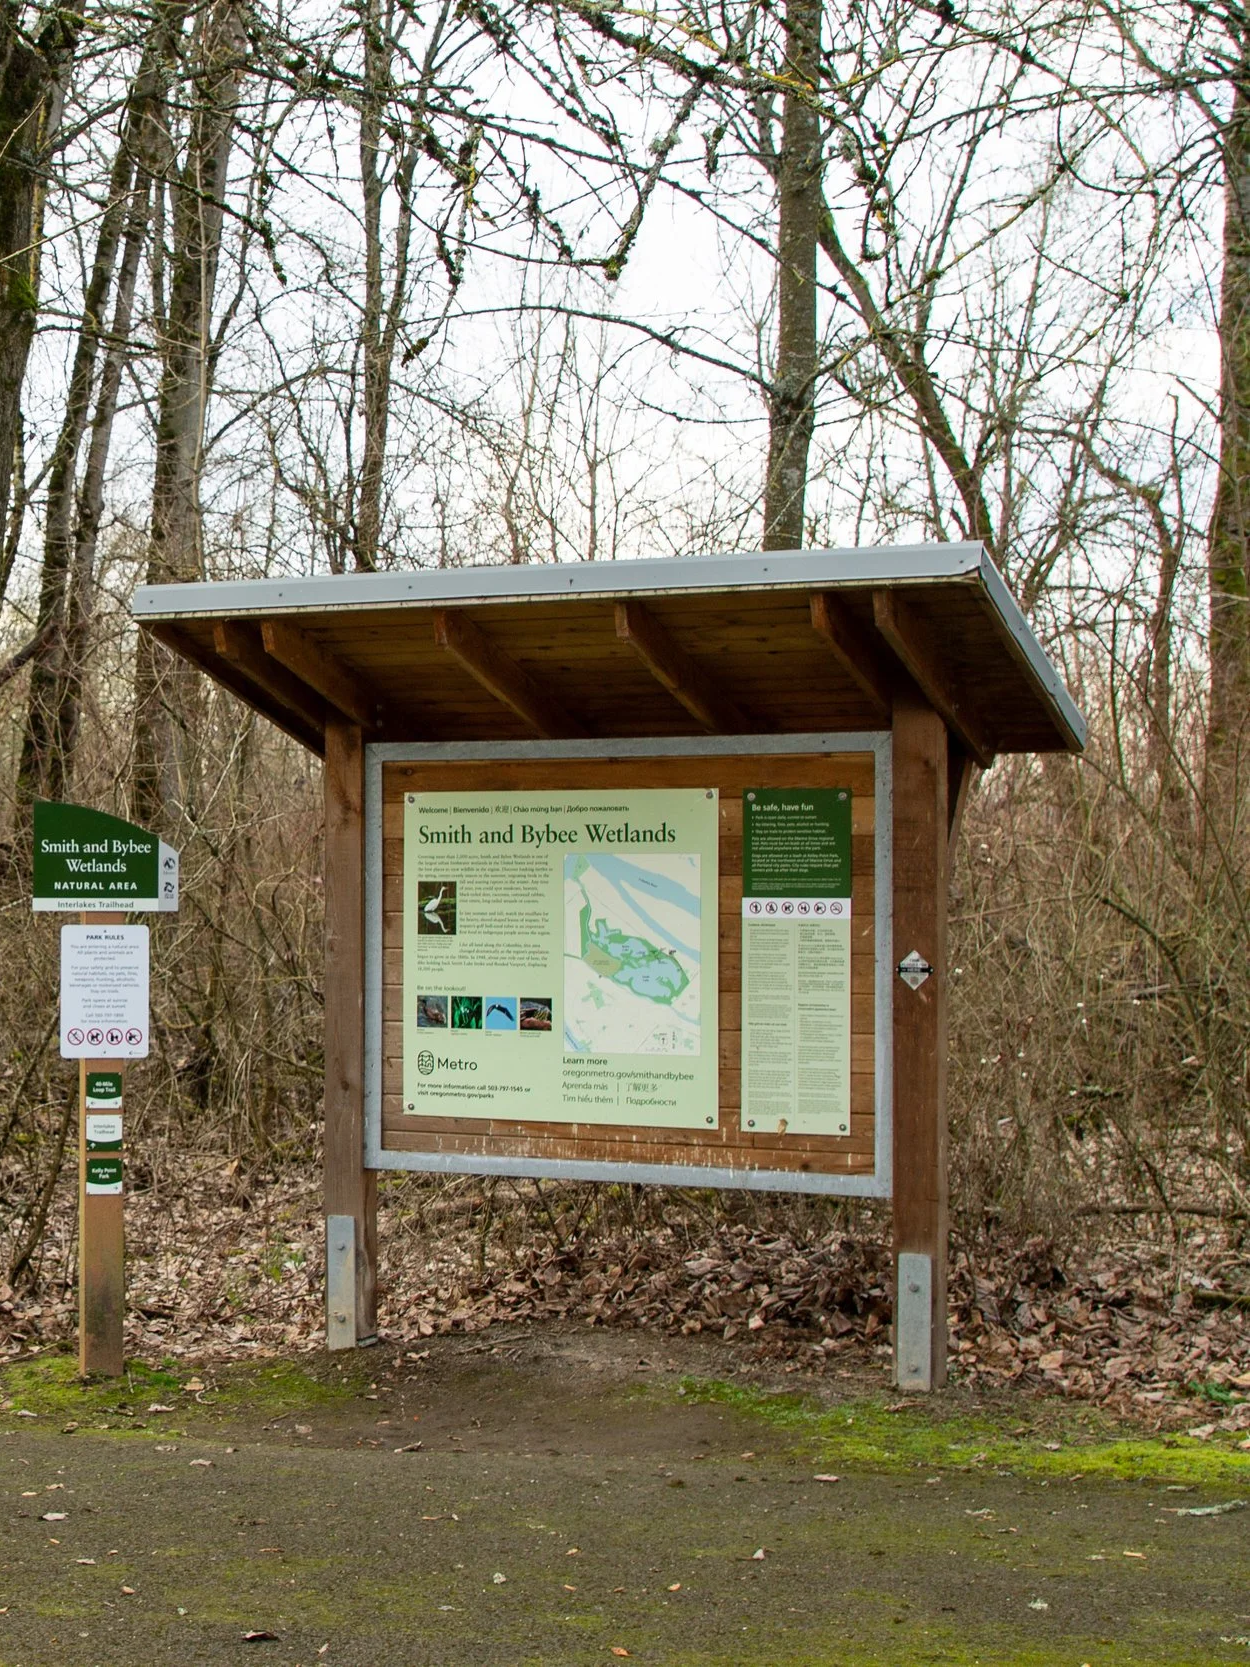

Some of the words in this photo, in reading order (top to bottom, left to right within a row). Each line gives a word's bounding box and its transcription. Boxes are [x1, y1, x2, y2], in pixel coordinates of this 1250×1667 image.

[567, 805, 588, 814] Добро
[419, 824, 471, 844] Smith
[479, 824, 514, 843] and
[521, 824, 578, 848] Bybee
[585, 822, 676, 843] Wetlands
[42, 839, 79, 853] Smith
[84, 839, 108, 853] and
[113, 839, 150, 856] Bybee
[67, 858, 126, 873] Wetlands
[54, 881, 104, 890] NATURAL
[109, 881, 137, 890] AREA
[58, 900, 96, 909] Interlakes
[99, 900, 134, 909] Trailhead
[438, 1058, 478, 1070] Metro
[562, 1070, 694, 1081] oregonmetro.gov/smithandbybee
[562, 1082, 592, 1091] Aprenda
[626, 1097, 676, 1106] Подробности
